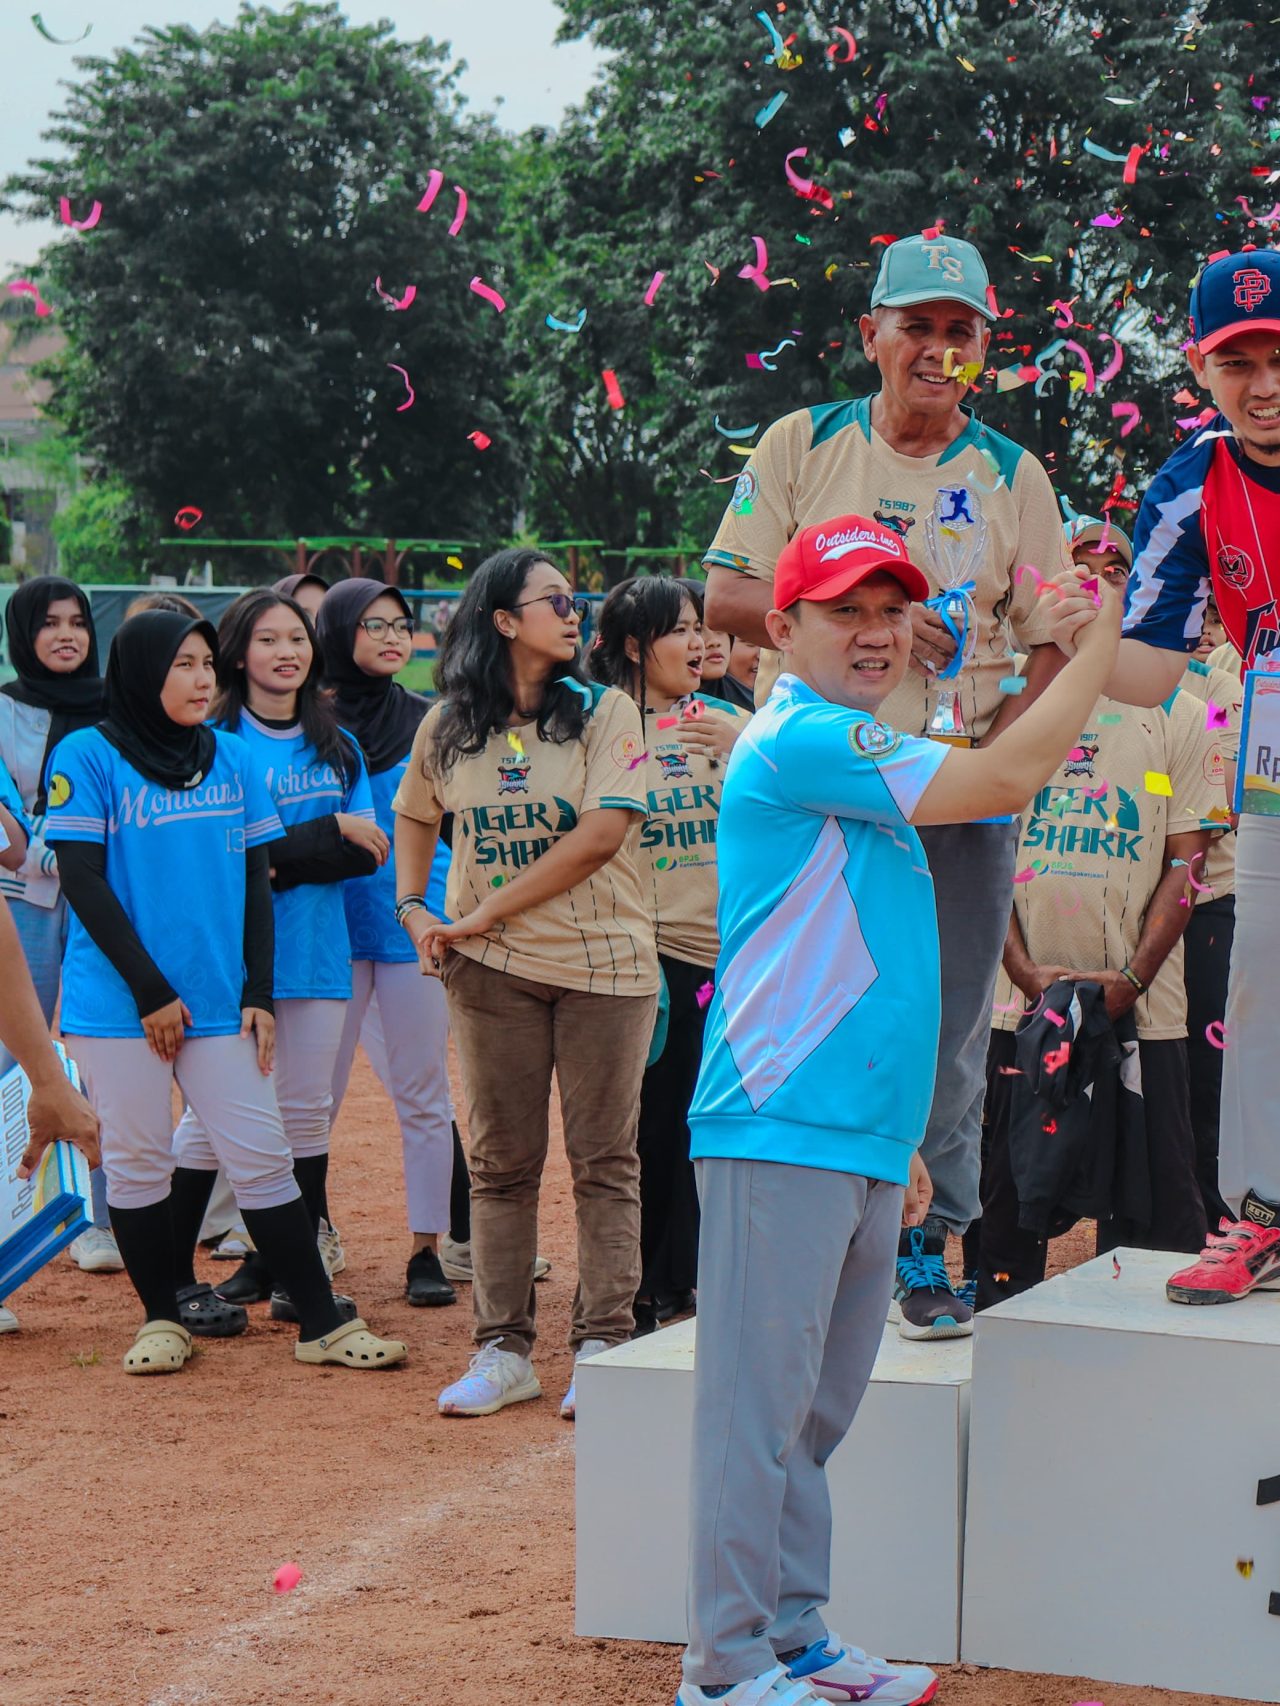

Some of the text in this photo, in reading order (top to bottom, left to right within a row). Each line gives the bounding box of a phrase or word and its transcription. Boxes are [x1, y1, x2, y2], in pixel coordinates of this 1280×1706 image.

[921, 244, 964, 283] TS
[265, 765, 346, 799] ohica
[460, 801, 553, 839] TIGER
[639, 818, 718, 851] SHA
[226, 827, 246, 854] 13
[1022, 815, 1145, 862] SHARK
[1247, 1203, 1276, 1224] ZETT
